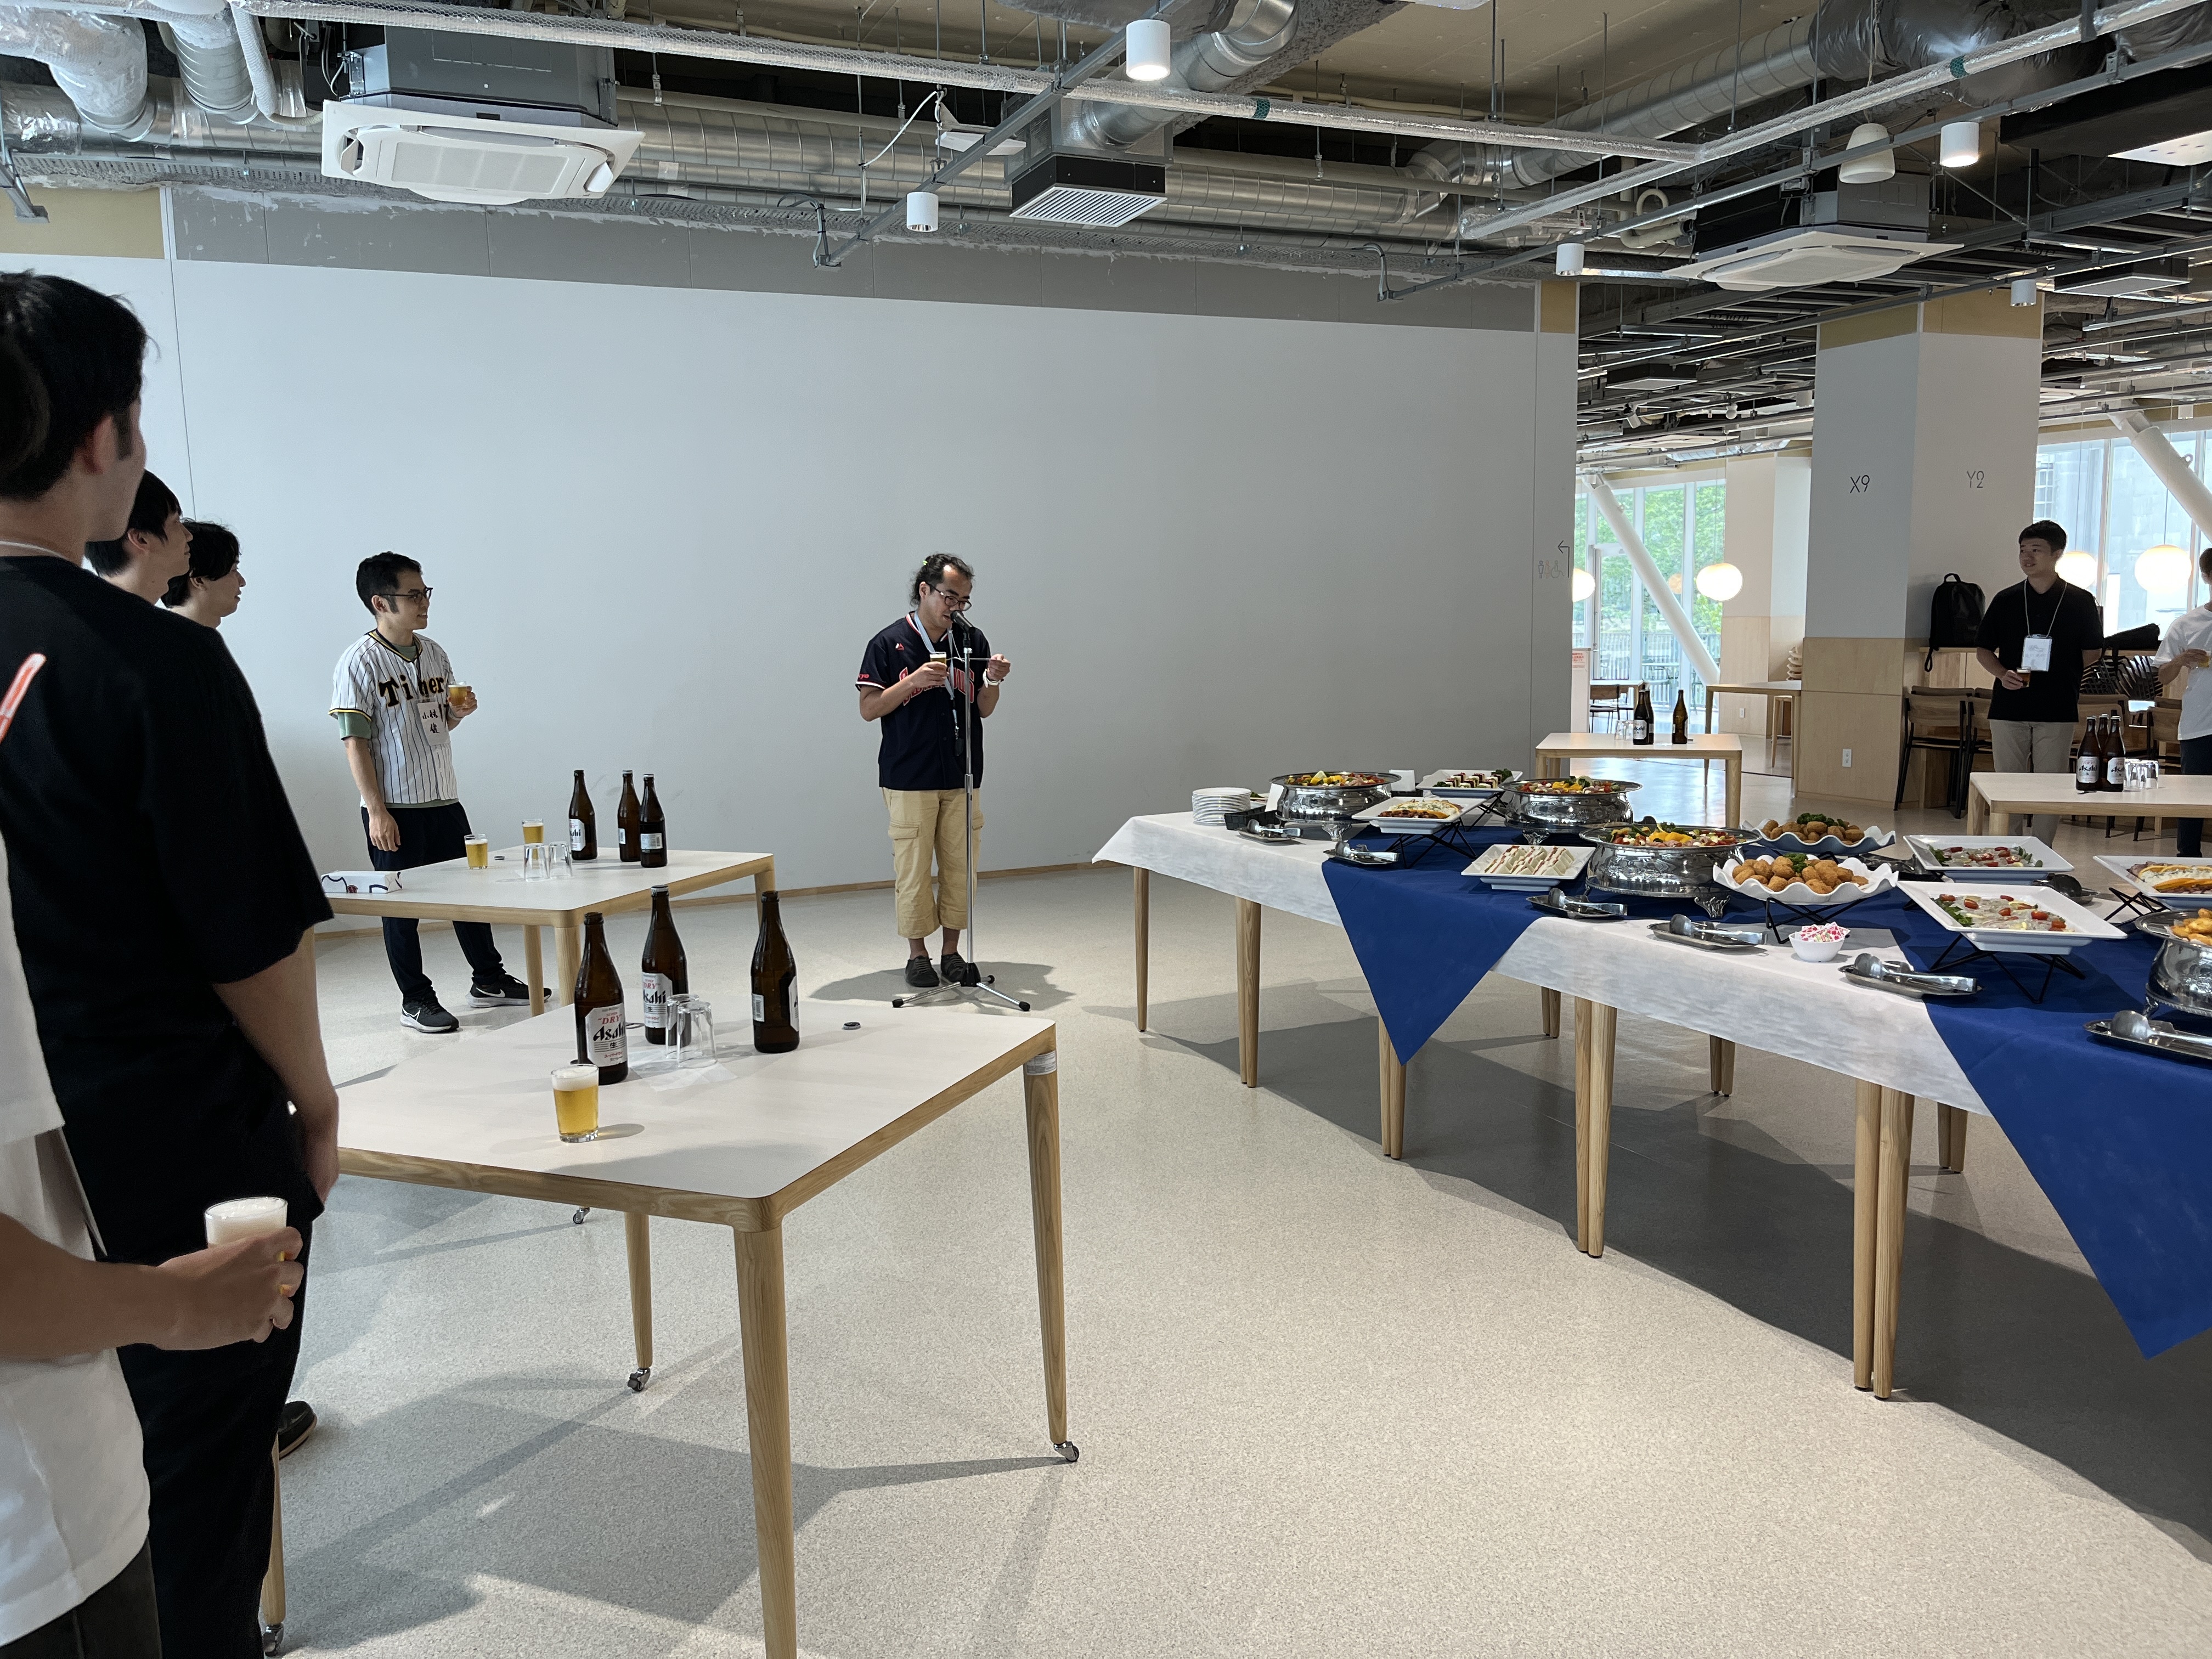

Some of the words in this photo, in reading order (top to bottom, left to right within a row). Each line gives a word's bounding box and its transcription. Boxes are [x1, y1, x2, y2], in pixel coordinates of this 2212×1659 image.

[1849, 475, 1870, 494] X9
[1966, 470, 1984, 488] Y2
[602, 1015, 619, 1025] DRY
